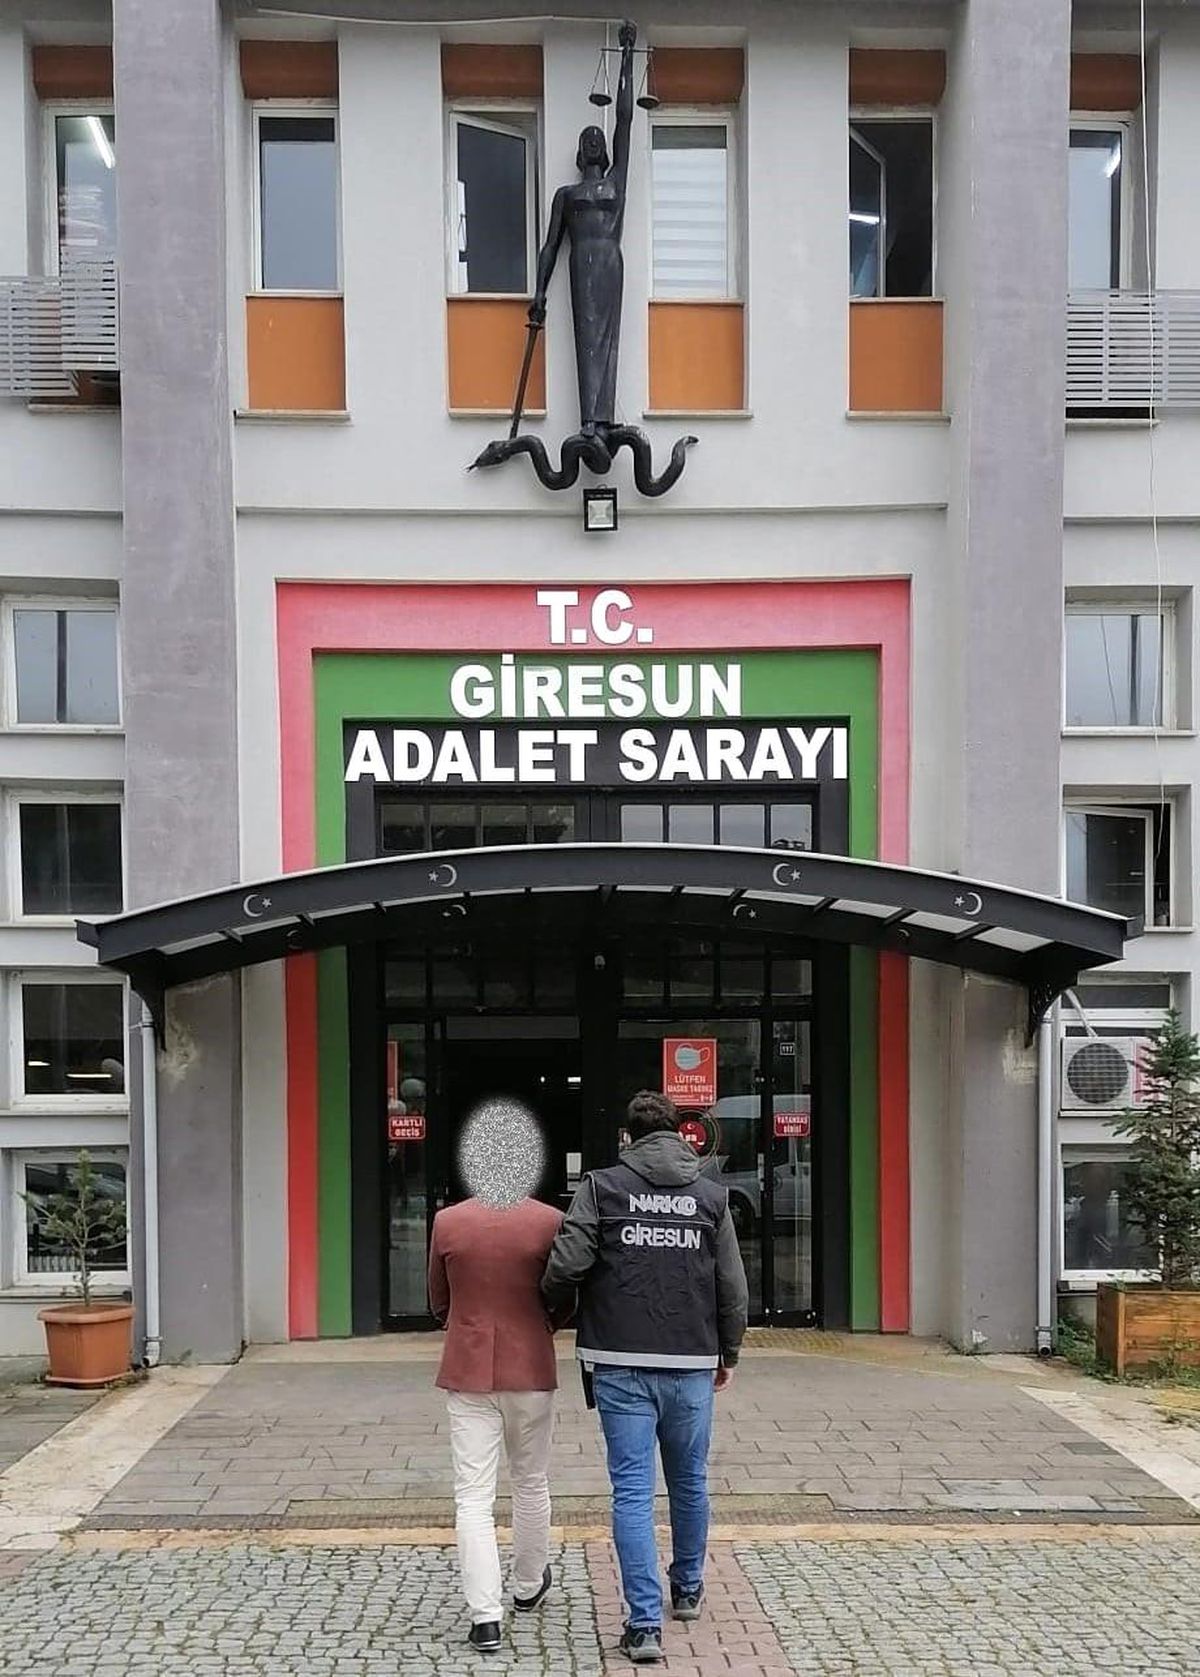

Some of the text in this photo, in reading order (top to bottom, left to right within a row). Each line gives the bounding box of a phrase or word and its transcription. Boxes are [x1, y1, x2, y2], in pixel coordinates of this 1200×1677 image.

[537, 589, 653, 645] T.C.
[450, 653, 742, 719] GİRESUN
[344, 726, 848, 782] ADALET SARAYI
[674, 1074, 706, 1084] LÜTFEN
[392, 1118, 423, 1127] KARTLI
